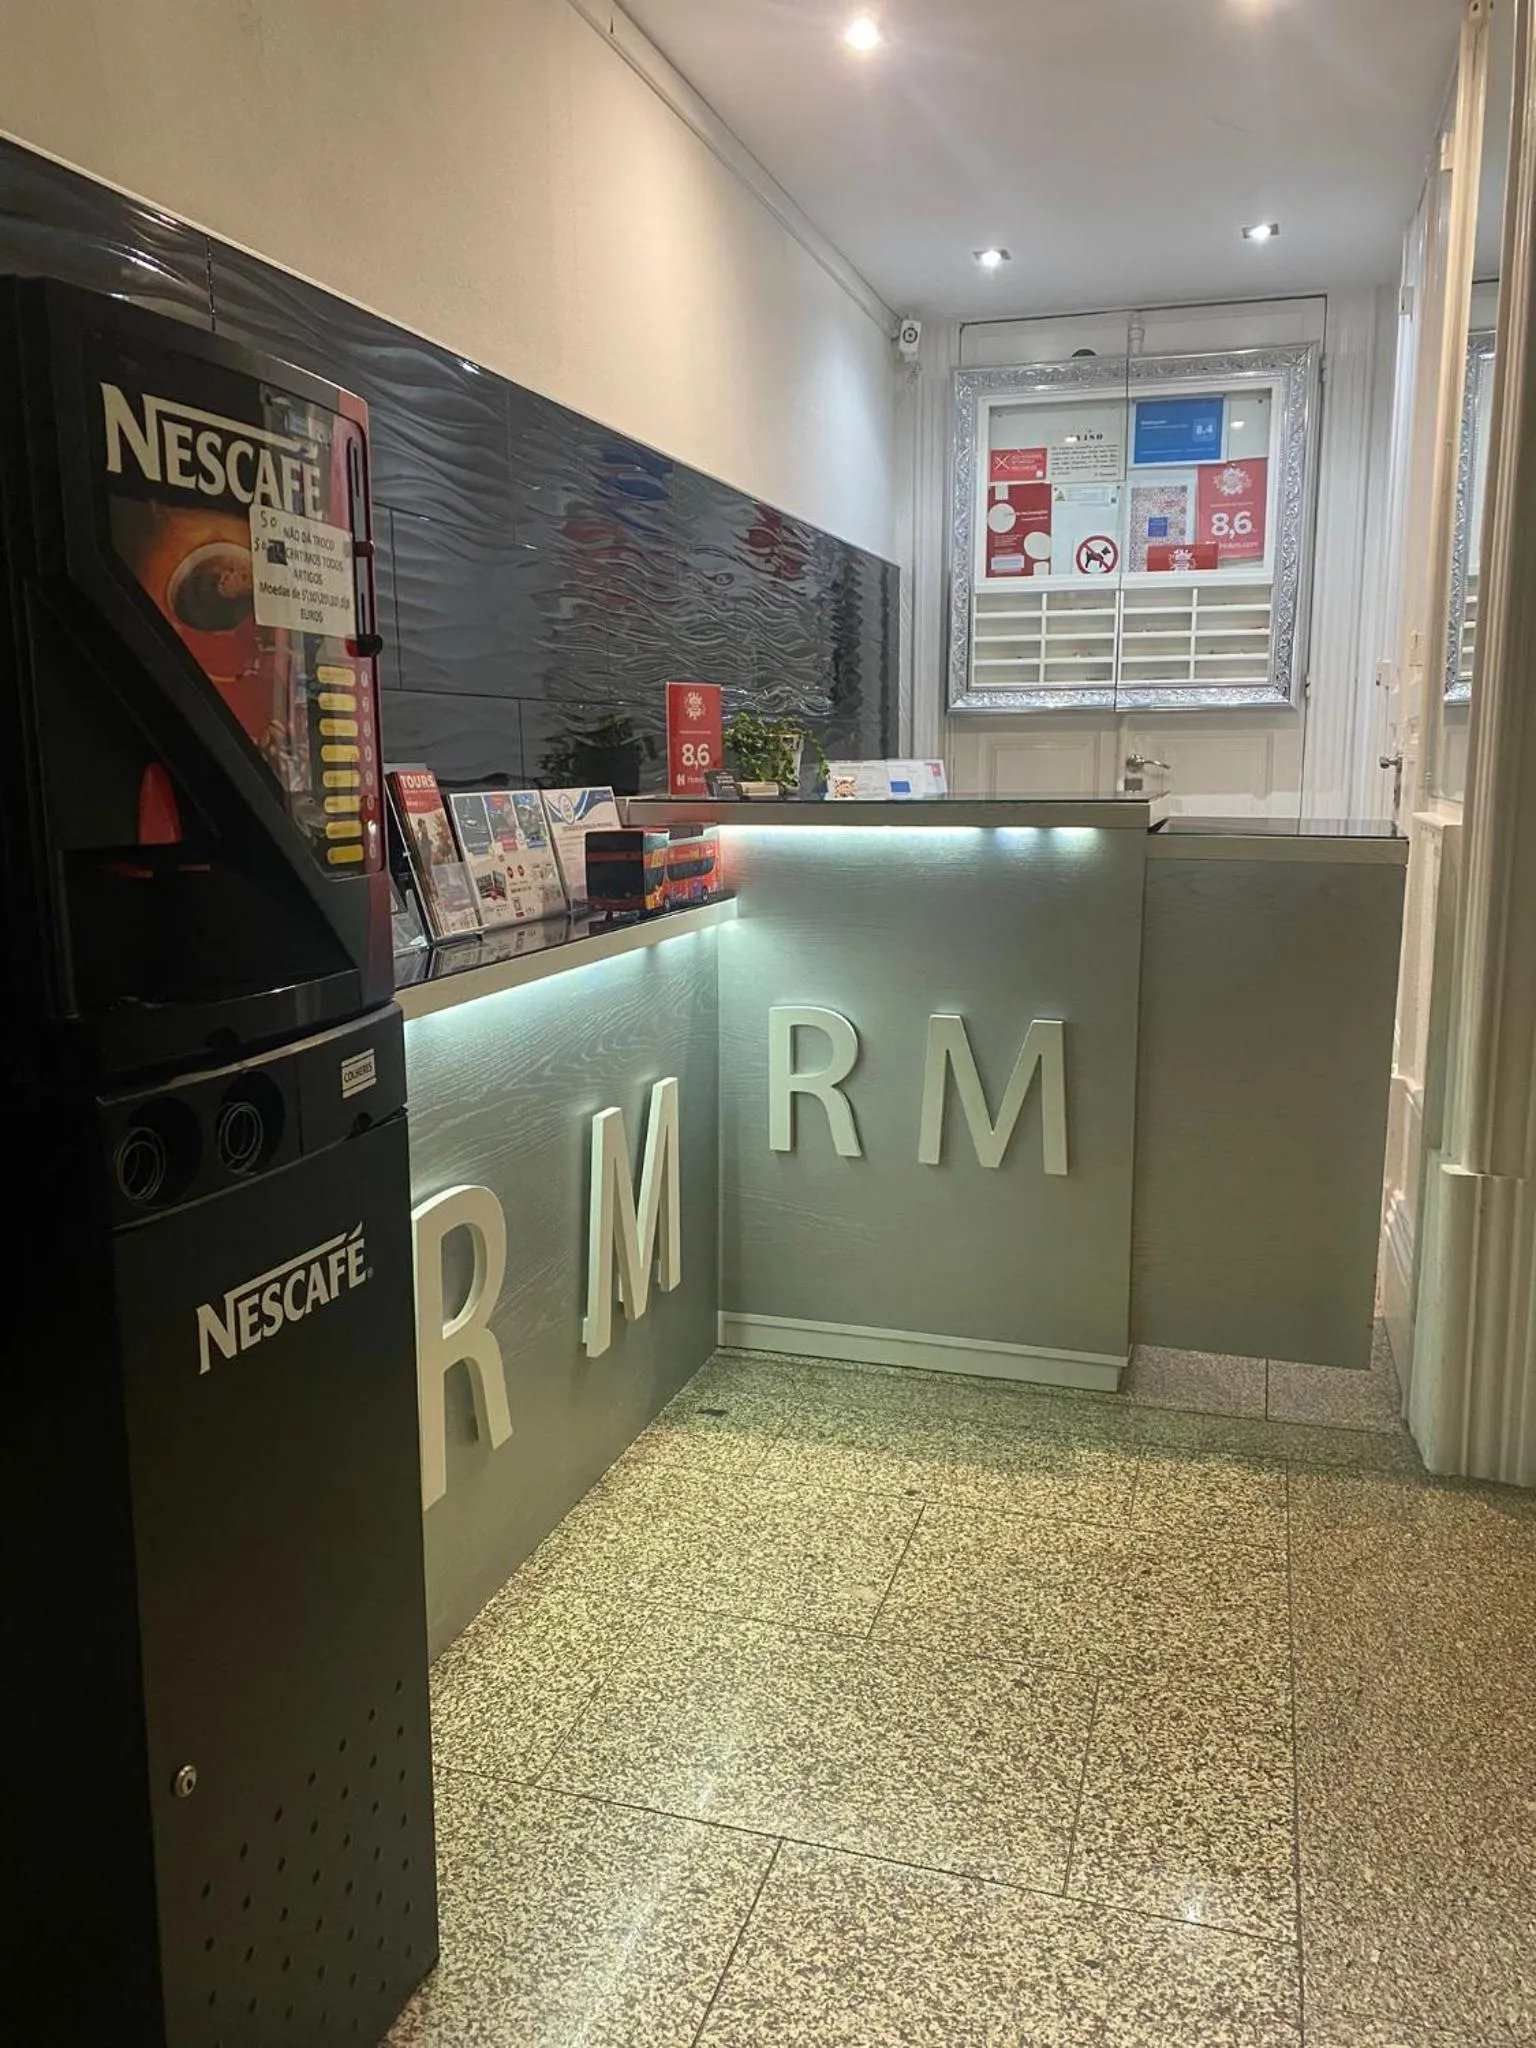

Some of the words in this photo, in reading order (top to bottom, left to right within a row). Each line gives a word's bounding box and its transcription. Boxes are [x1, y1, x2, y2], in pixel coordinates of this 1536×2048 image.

[1211, 511, 1253, 539] 8,6
[682, 743, 710, 769] 8,6
[399, 775, 435, 788] TOURS
[196, 1222, 367, 1376] NESCAFÉ
